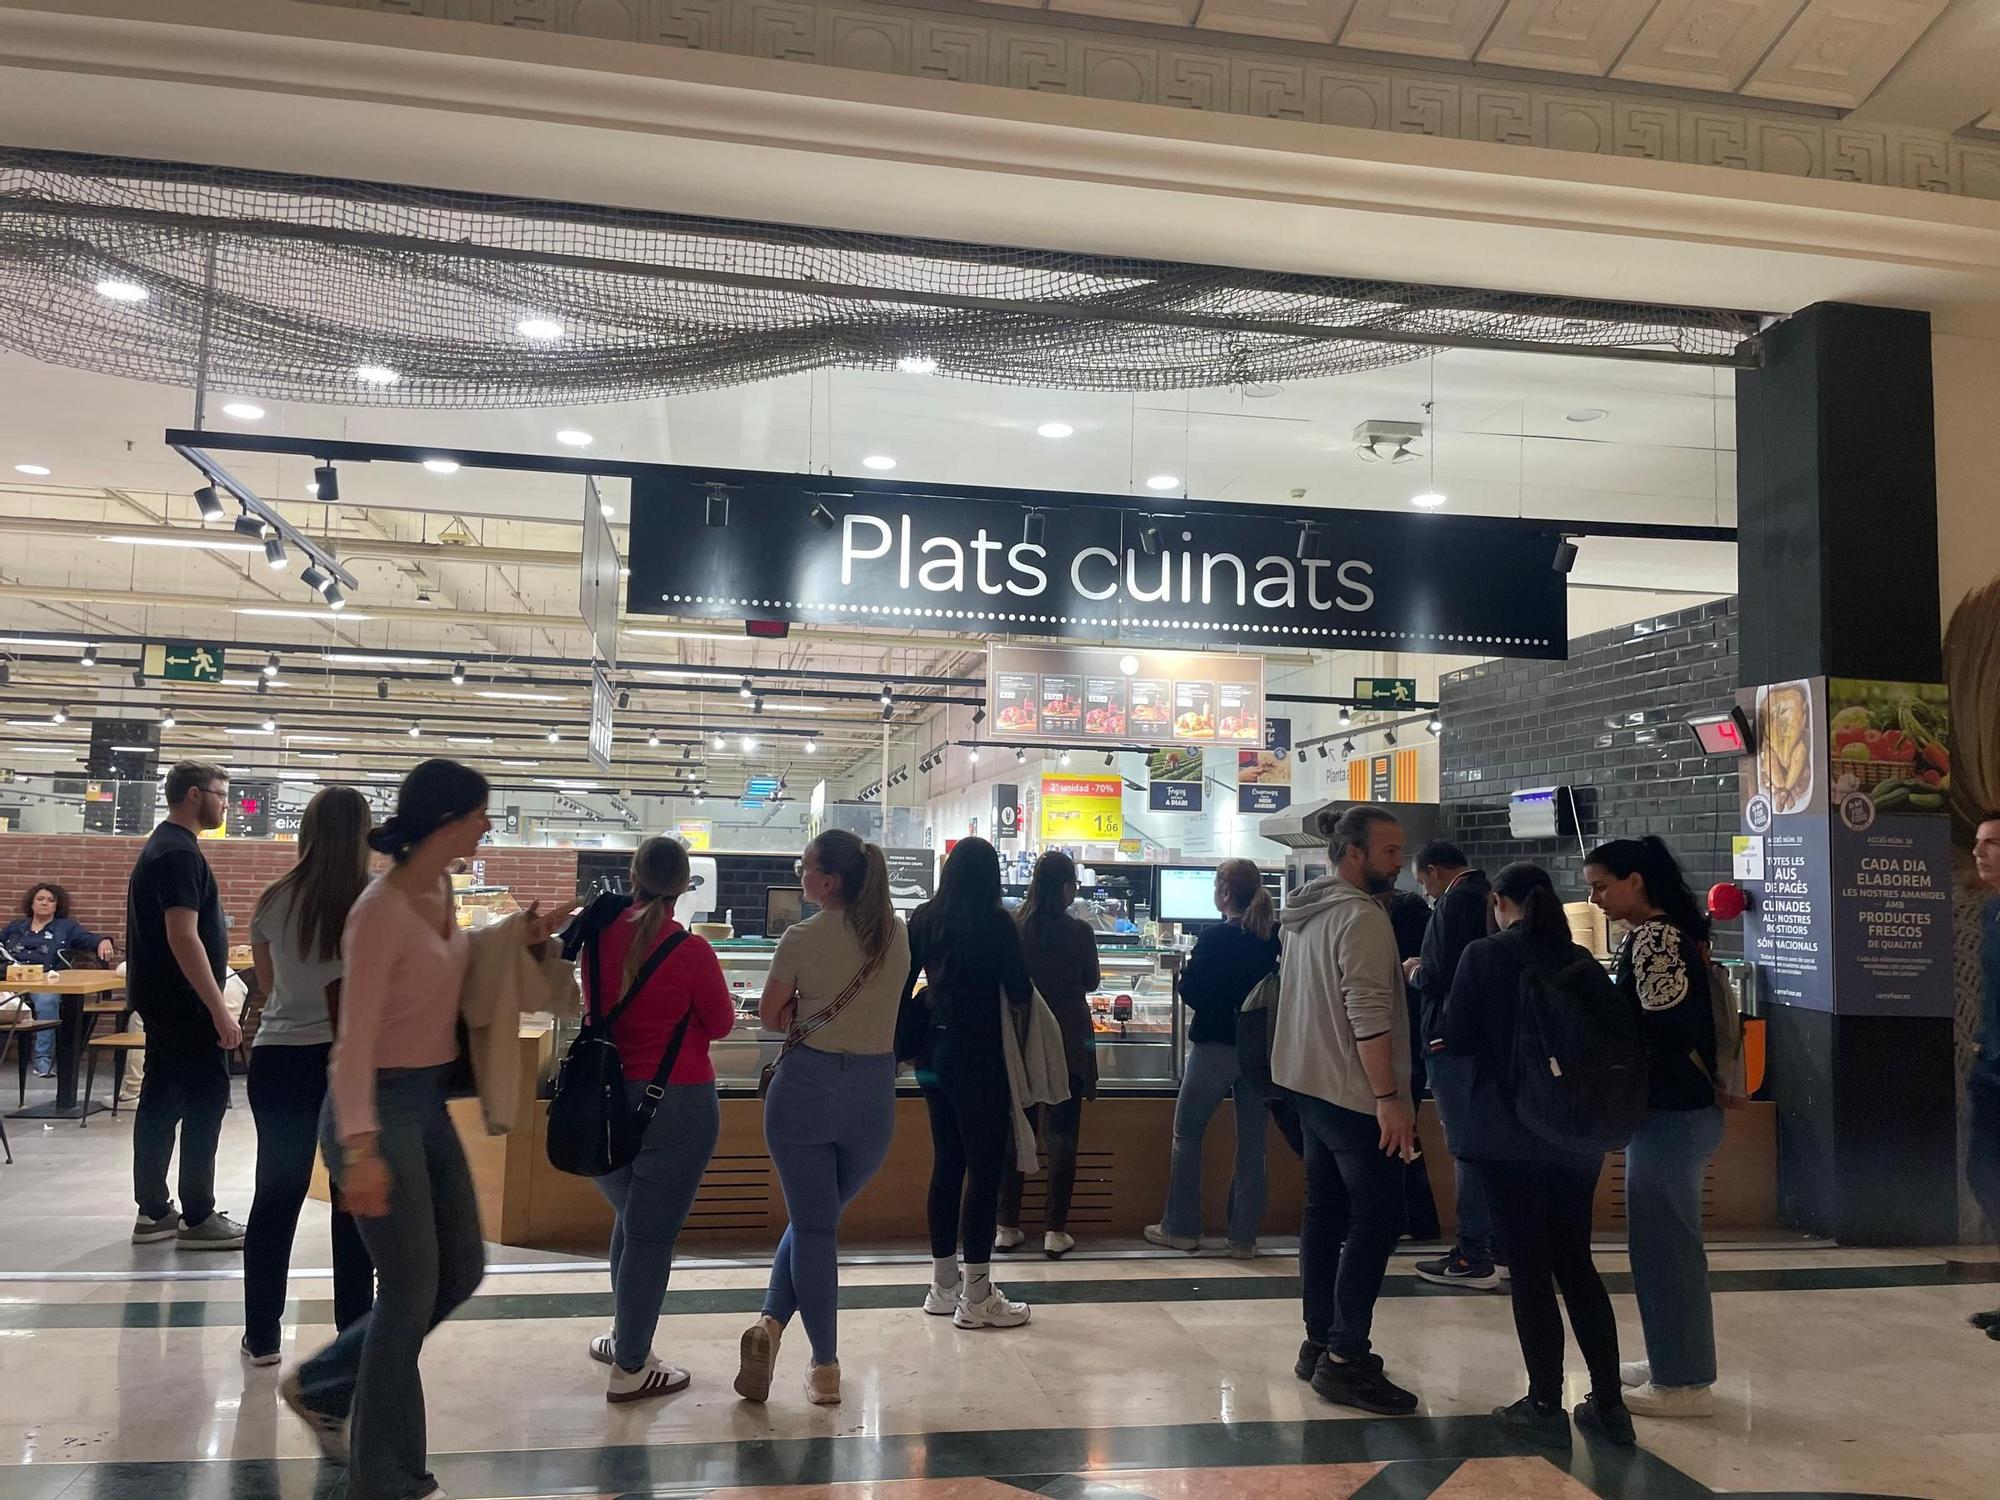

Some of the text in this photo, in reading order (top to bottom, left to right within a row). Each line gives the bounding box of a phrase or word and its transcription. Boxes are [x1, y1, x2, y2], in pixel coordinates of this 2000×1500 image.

[840, 514, 1374, 613] Plats cuinats
[1718, 721, 1741, 749] 4
[1326, 768, 1346, 784] Planta
[1061, 783, 1089, 792] unidad
[1091, 784, 1114, 793] -70%
[1791, 857, 1805, 866] LES
[1861, 858, 1927, 872] CADA DIA
[1774, 867, 1797, 880] AUS
[1857, 873, 1931, 887] ELABOREM
[1764, 880, 1808, 894] DE PAGÈS
[1842, 888, 1946, 900] LES NOSTRES AMANIDES
[1885, 900, 1905, 909] AMB
[1778, 914, 1811, 925] NOSTRES
[1859, 912, 1931, 924] PRODUCTES
[1868, 925, 1922, 938] FRESCOS
[1757, 936, 1818, 952] SÓN NACIONALS
[1868, 940, 1923, 950] DE QUALITAT
